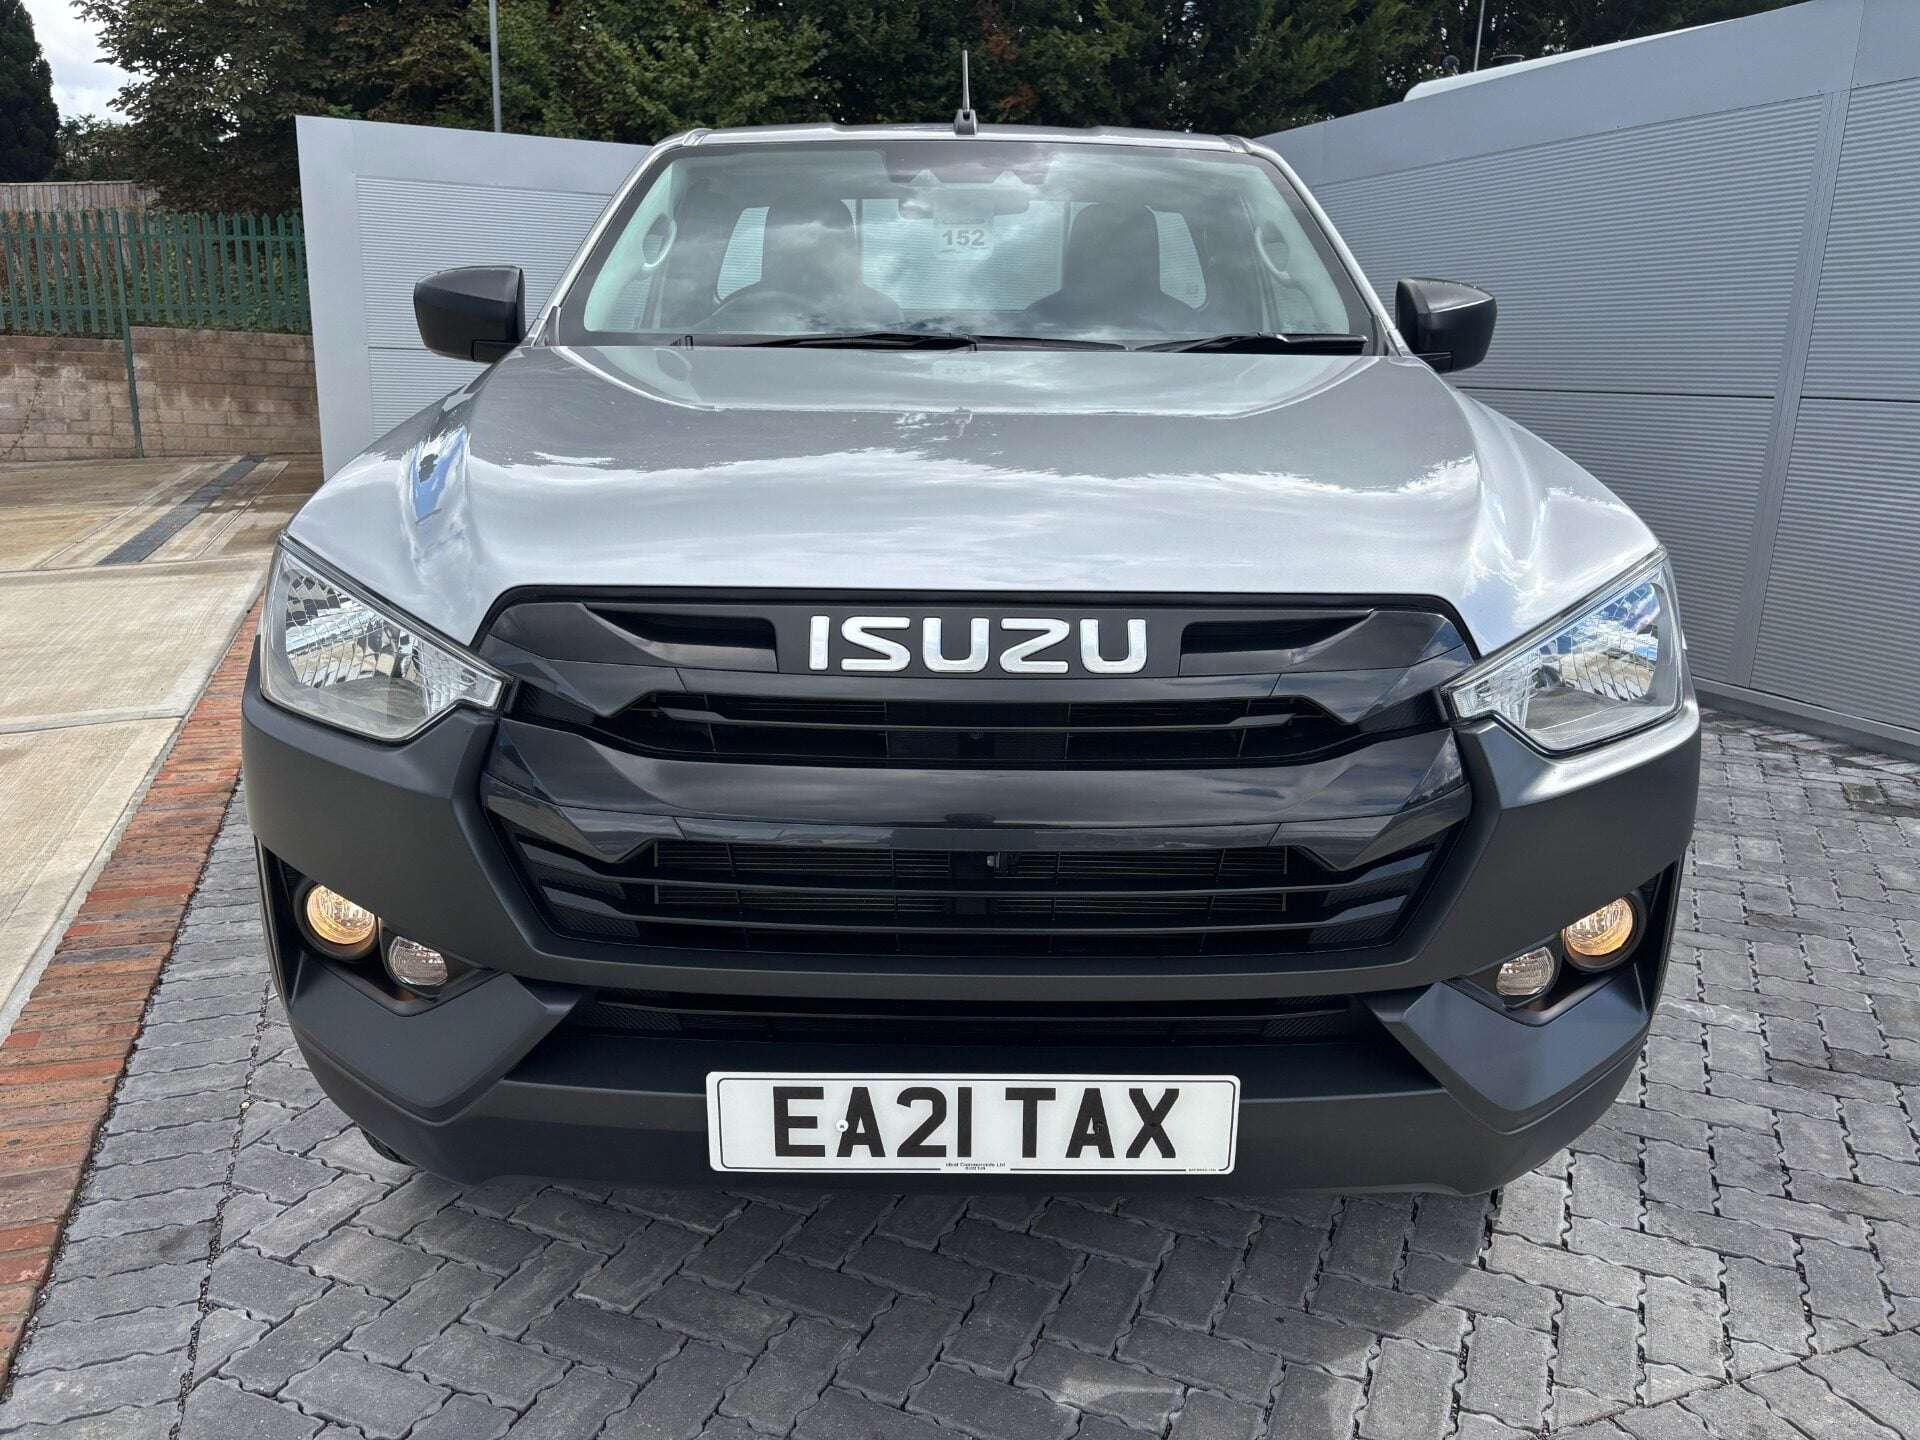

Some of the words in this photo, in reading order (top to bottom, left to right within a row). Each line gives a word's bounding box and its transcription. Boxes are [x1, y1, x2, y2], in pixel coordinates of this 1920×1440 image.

[942, 229, 985, 246] 152
[808, 615, 1147, 674] ISUZU
[772, 1086, 972, 1158] EA21
[1004, 1087, 1181, 1158] TAX
